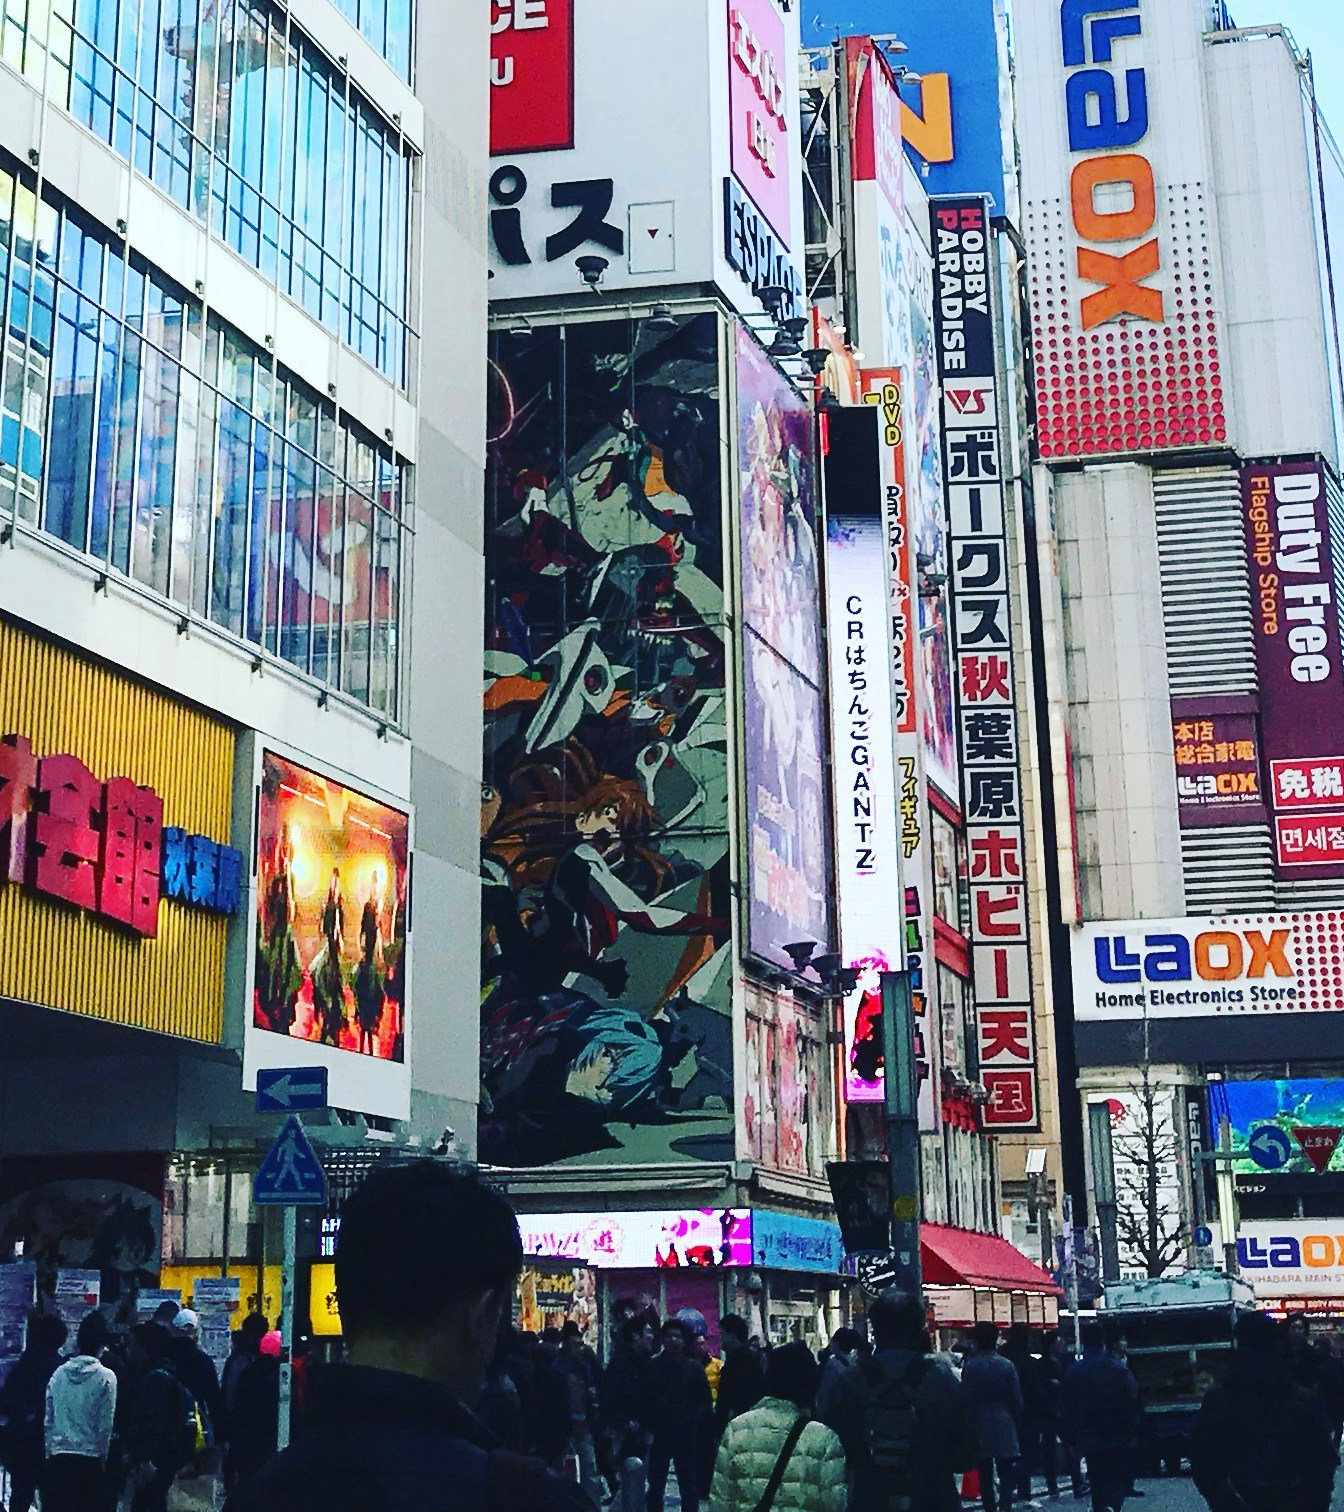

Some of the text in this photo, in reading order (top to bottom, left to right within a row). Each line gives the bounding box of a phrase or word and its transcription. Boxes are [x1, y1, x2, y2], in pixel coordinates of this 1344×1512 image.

[935, 207, 967, 372] PARADISE
[960, 207, 990, 316] HOBBY
[882, 383, 902, 447] DVD
[1248, 475, 1280, 637] Flagship Store
[1272, 471, 1332, 685] Duty Free
[1173, 719, 1215, 743] 本店
[1174, 739, 1257, 766] 総合家電
[1276, 765, 1344, 801] 免税
[1094, 983, 1298, 1009] Home Electronics Store
